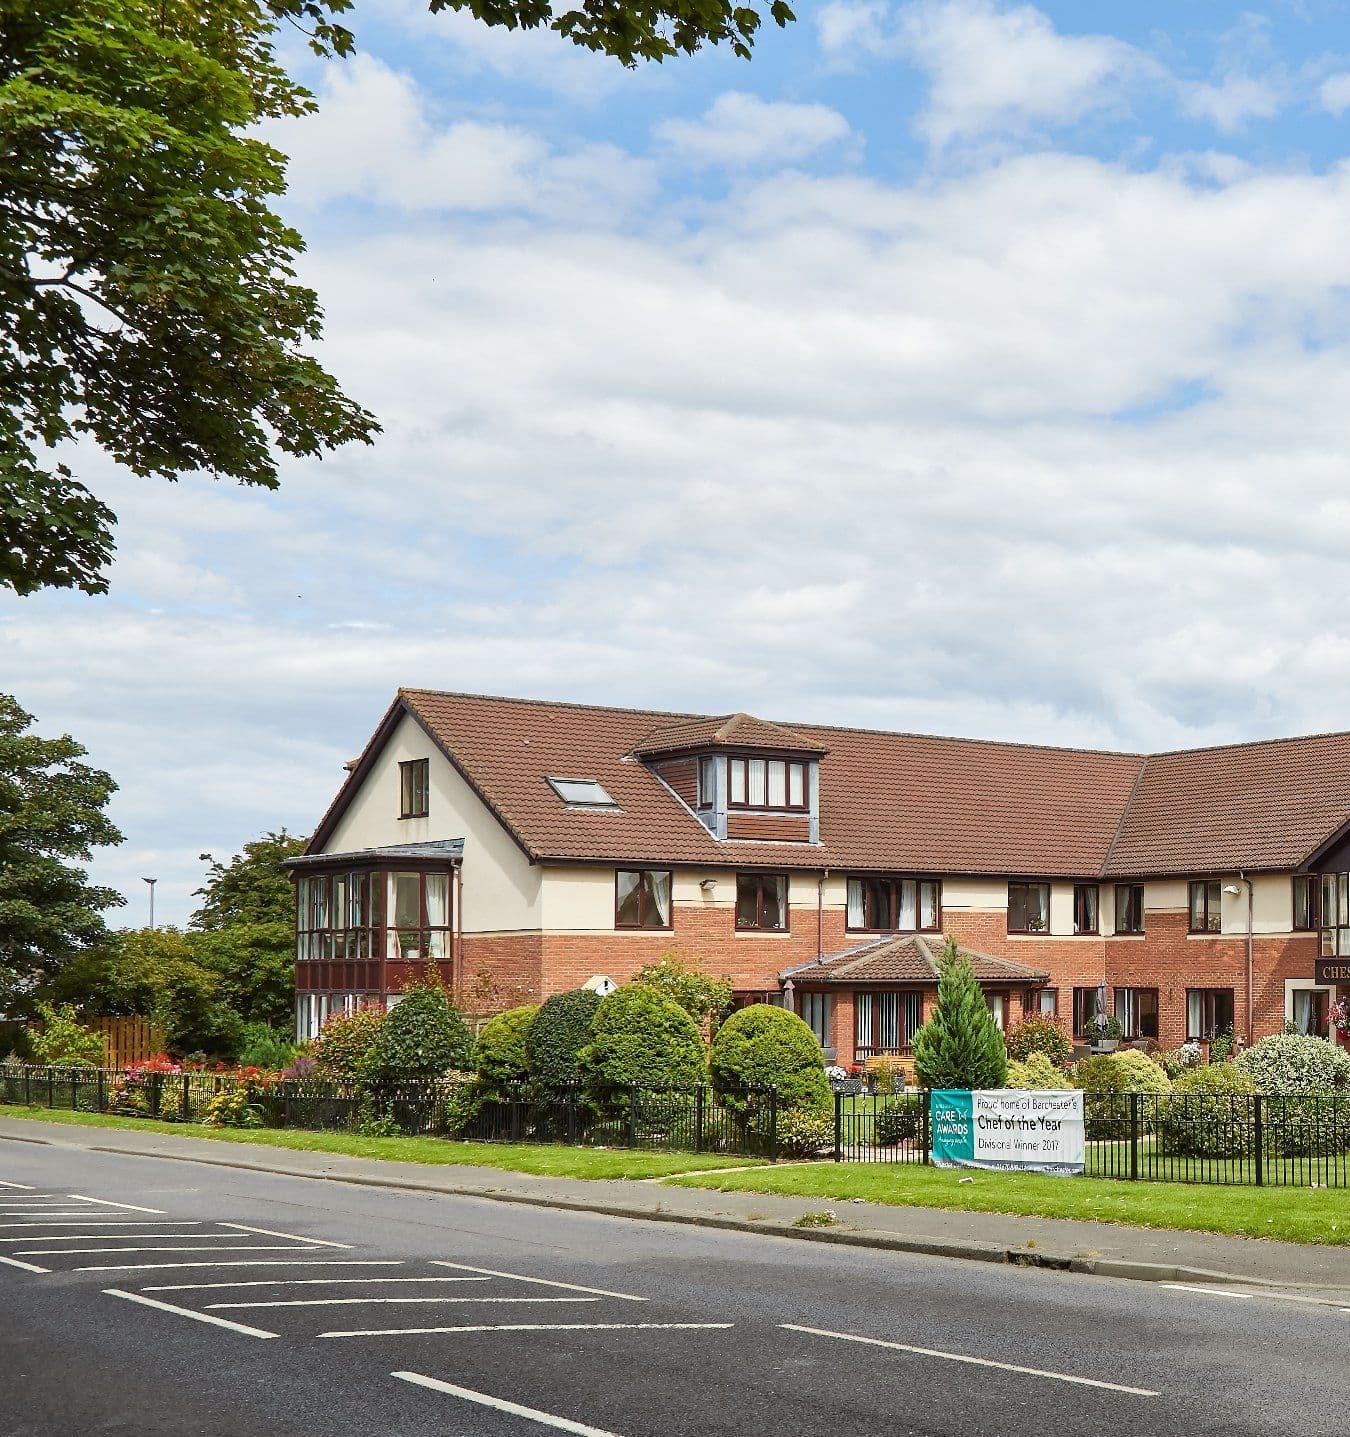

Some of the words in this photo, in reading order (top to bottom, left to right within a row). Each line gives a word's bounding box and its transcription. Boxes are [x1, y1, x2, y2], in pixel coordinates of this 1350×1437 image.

[977, 1098, 998, 1109] Proud
[1000, 1099, 1020, 1110] home
[1021, 1099, 1030, 1110] of
[1032, 1098, 1077, 1110] Barchester's
[935, 1110, 956, 1121] CARE
[977, 1114, 1002, 1130] Chef
[1004, 1114, 1015, 1130] of
[1017, 1115, 1036, 1130] the
[1037, 1116, 1062, 1131] Year
[936, 1123, 969, 1135] AWARDS
[978, 1137, 1010, 1149] Divisional
[1013, 1139, 1040, 1150] Winner
[1042, 1140, 1059, 1151] 2017
